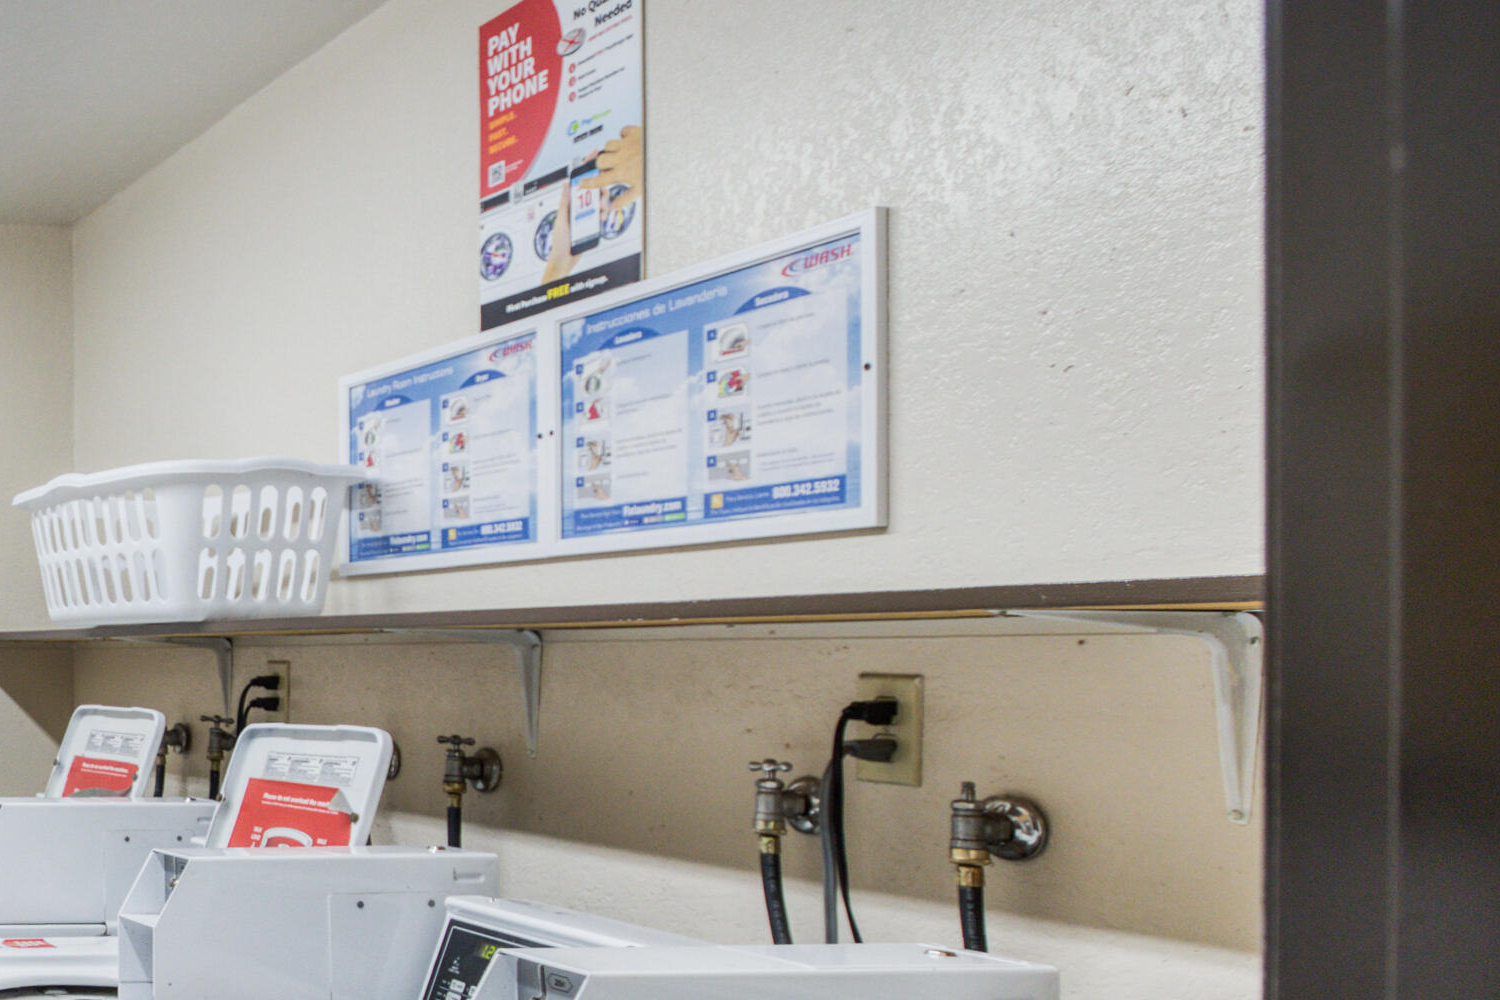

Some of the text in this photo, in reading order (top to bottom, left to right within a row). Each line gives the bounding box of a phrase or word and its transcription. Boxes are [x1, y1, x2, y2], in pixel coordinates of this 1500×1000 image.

[595, 0, 632, 27] Needed
[487, 36, 532, 76] WITH
[488, 22, 520, 57] PAY
[487, 57, 535, 96] YOUR
[488, 69, 549, 117] PHONE
[804, 243, 852, 269] WASH
[547, 283, 571, 300] FREE
[586, 308, 650, 335] Instrucciones
[652, 303, 667, 317] de
